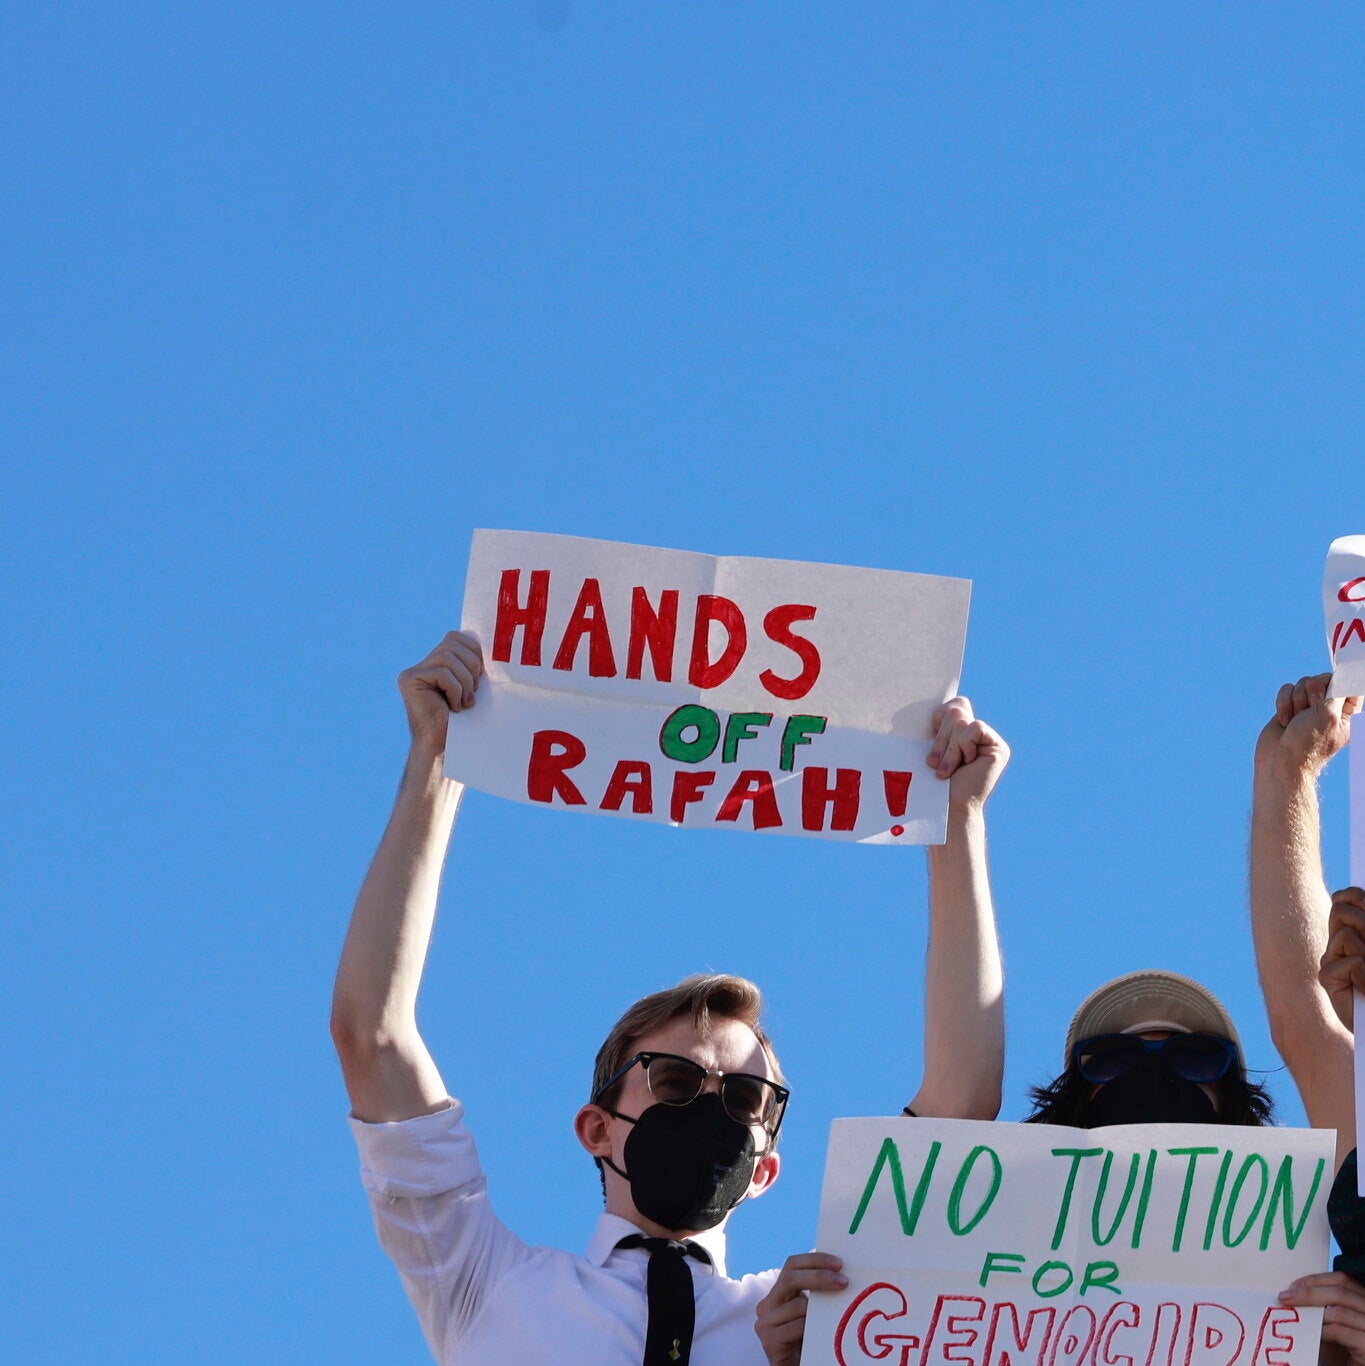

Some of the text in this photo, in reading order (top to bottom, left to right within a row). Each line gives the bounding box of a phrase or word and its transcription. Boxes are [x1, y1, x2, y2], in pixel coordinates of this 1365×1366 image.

[492, 568, 822, 700] HANDS
[527, 730, 912, 837] RAFAH!
[660, 704, 828, 771] OFF
[849, 1137, 1325, 1252] NO TUITION
[979, 1251, 1122, 1298] FOR
